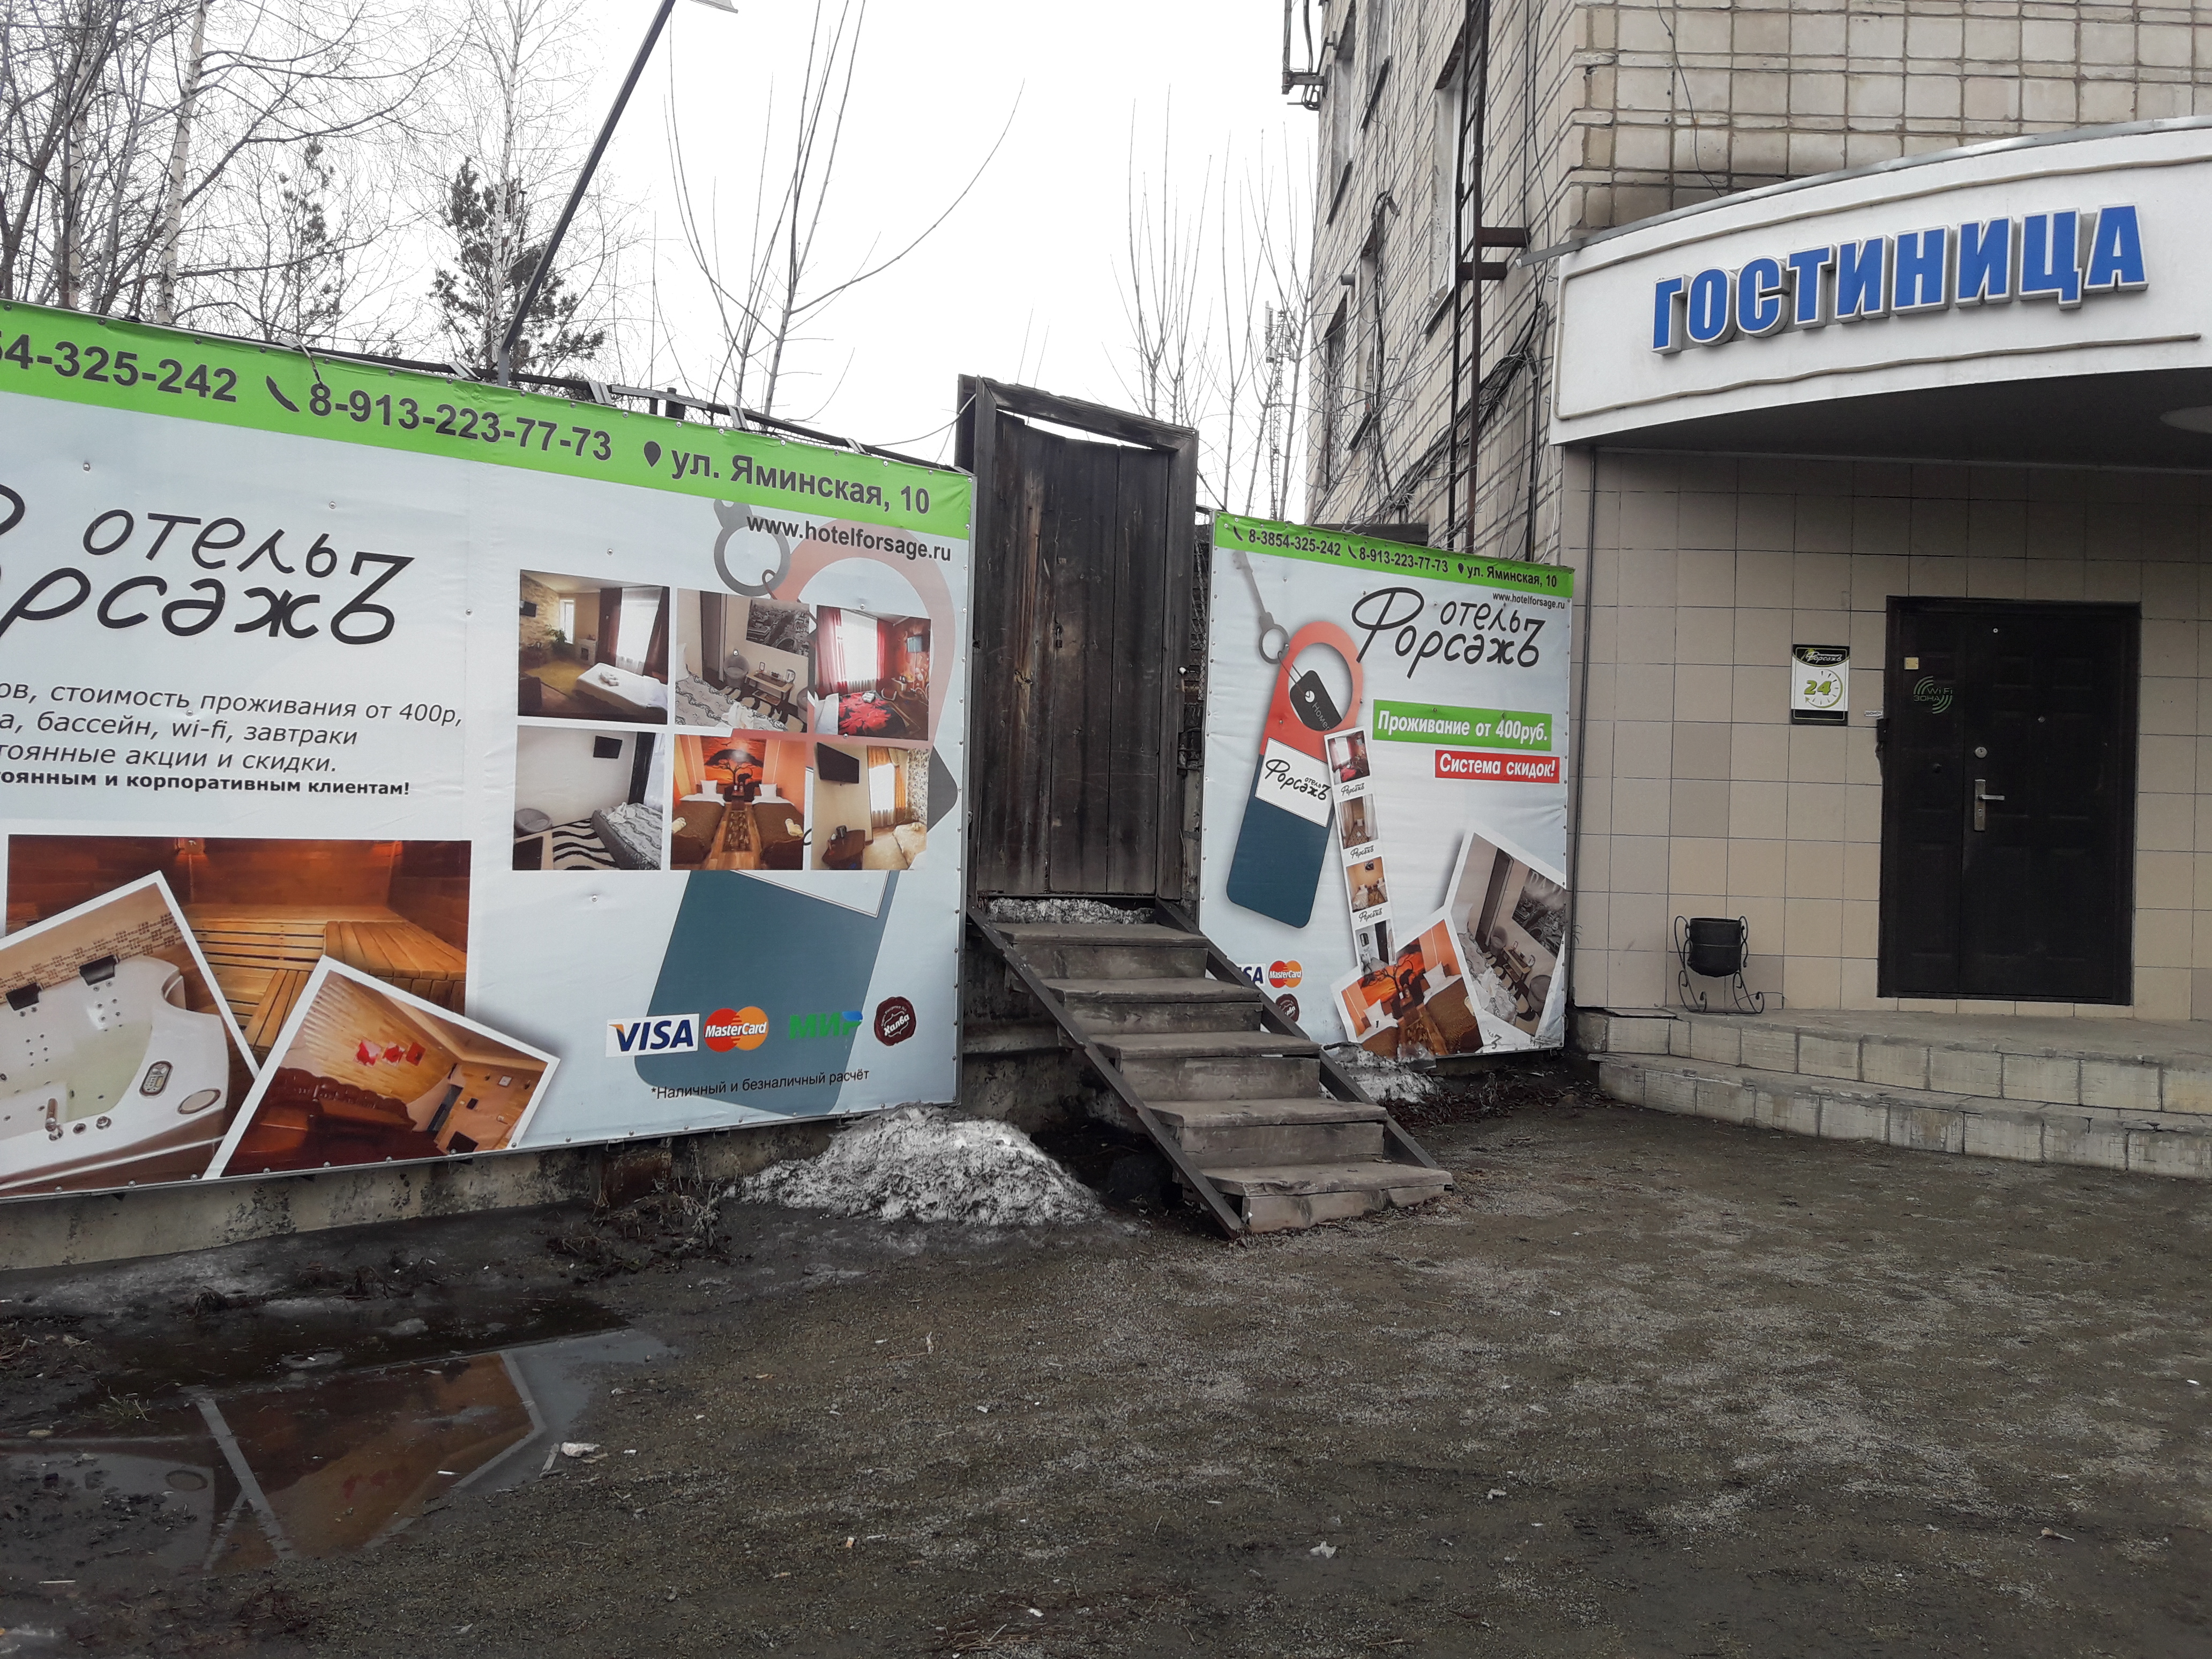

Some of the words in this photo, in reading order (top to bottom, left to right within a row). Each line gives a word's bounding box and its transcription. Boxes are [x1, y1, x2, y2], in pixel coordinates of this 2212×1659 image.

[1651, 202, 2148, 355] ГОСТИНИЦА
[0, 330, 237, 402] 4-325-242
[309, 383, 612, 461] 8-913-223-77-73
[670, 450, 720, 480] ул.
[730, 454, 891, 512] Яминская,
[901, 485, 930, 514] 10
[746, 516, 951, 562] www.hotelforsage.ru
[1248, 528, 1341, 557] 8-3854-325-242
[1359, 547, 1448, 573] 8-913-223-77-73
[0, 485, 415, 645] рсажъ
[1467, 565, 1484, 579] ул.
[1487, 565, 1542, 587] Яминская,
[1546, 574, 1557, 588] 10
[1492, 592, 1566, 610] www.hotelforsage.ru
[1804, 679, 1832, 696] 24
[0, 683, 38, 704] ов,
[50, 686, 190, 708] стоимость
[200, 695, 357, 718] проживания
[365, 704, 392, 719] от
[399, 703, 463, 727] 400р,
[37, 711, 159, 740] бассейн,
[172, 719, 233, 743] wi-fi,
[243, 726, 358, 746] завтраки
[1378, 710, 1470, 736] Проживание
[1475, 722, 1492, 737] от
[1495, 720, 1548, 745] 400руб.
[125, 750, 208, 768] акции
[217, 753, 233, 768] и
[242, 754, 336, 773] скидки.
[1439, 753, 1501, 775] Система
[1506, 760, 1556, 779] скидок!
[0, 771, 96, 786] оянным
[105, 775, 118, 786] и
[126, 775, 301, 793] корпоративным
[308, 781, 409, 795] клиентам!
[1269, 970, 1302, 979] MasterCard
[608, 1020, 694, 1052] VISA
[705, 1021, 767, 1038] MasterCard
[789, 1011, 863, 1040] МИР
[730, 1082, 738, 1092] и
[742, 1072, 826, 1092] безналичный
[829, 1069, 870, 1088] расчёт
